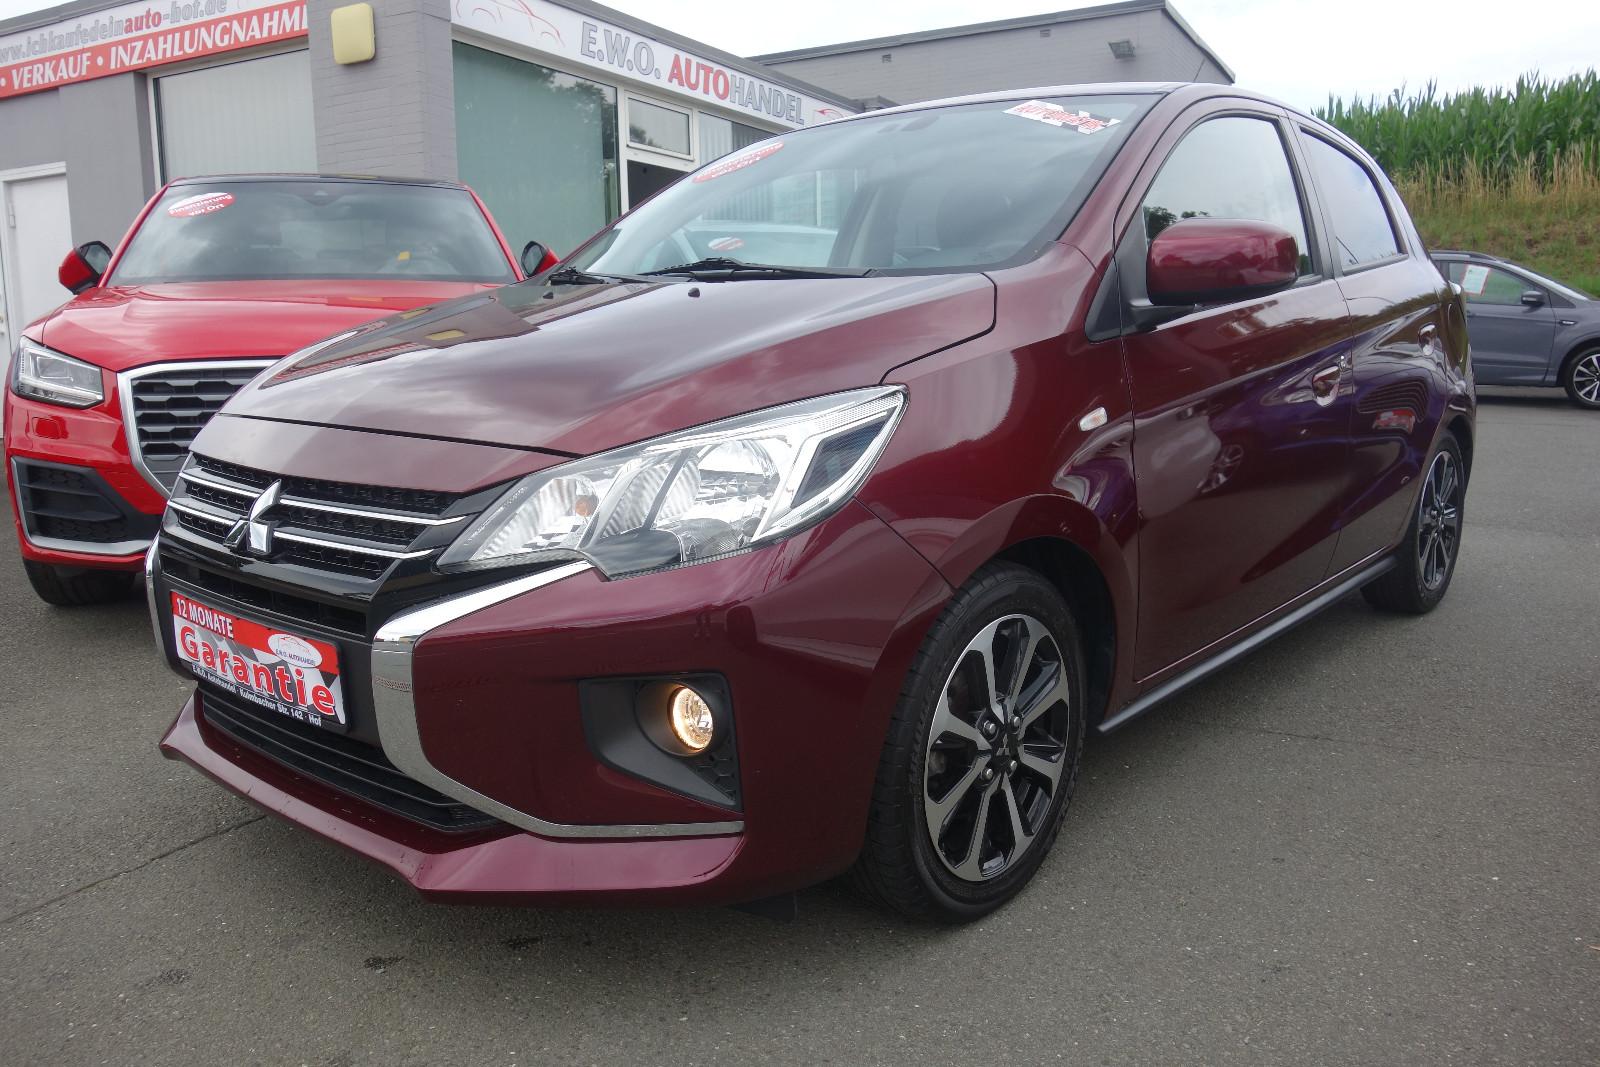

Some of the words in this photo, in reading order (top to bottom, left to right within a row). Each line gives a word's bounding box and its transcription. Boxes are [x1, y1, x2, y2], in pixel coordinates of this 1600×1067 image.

[11, 52, 91, 90] VERKAUF
[581, 21, 661, 79] E.W.O.
[667, 54, 804, 125] AUTOHANDEL
[206, 203, 225, 211] Ort
[176, 598, 187, 618] 12
[189, 602, 234, 638] MONATE
[180, 625, 336, 715] Garantie
[291, 708, 304, 720] 142
[308, 713, 322, 727] Hof
